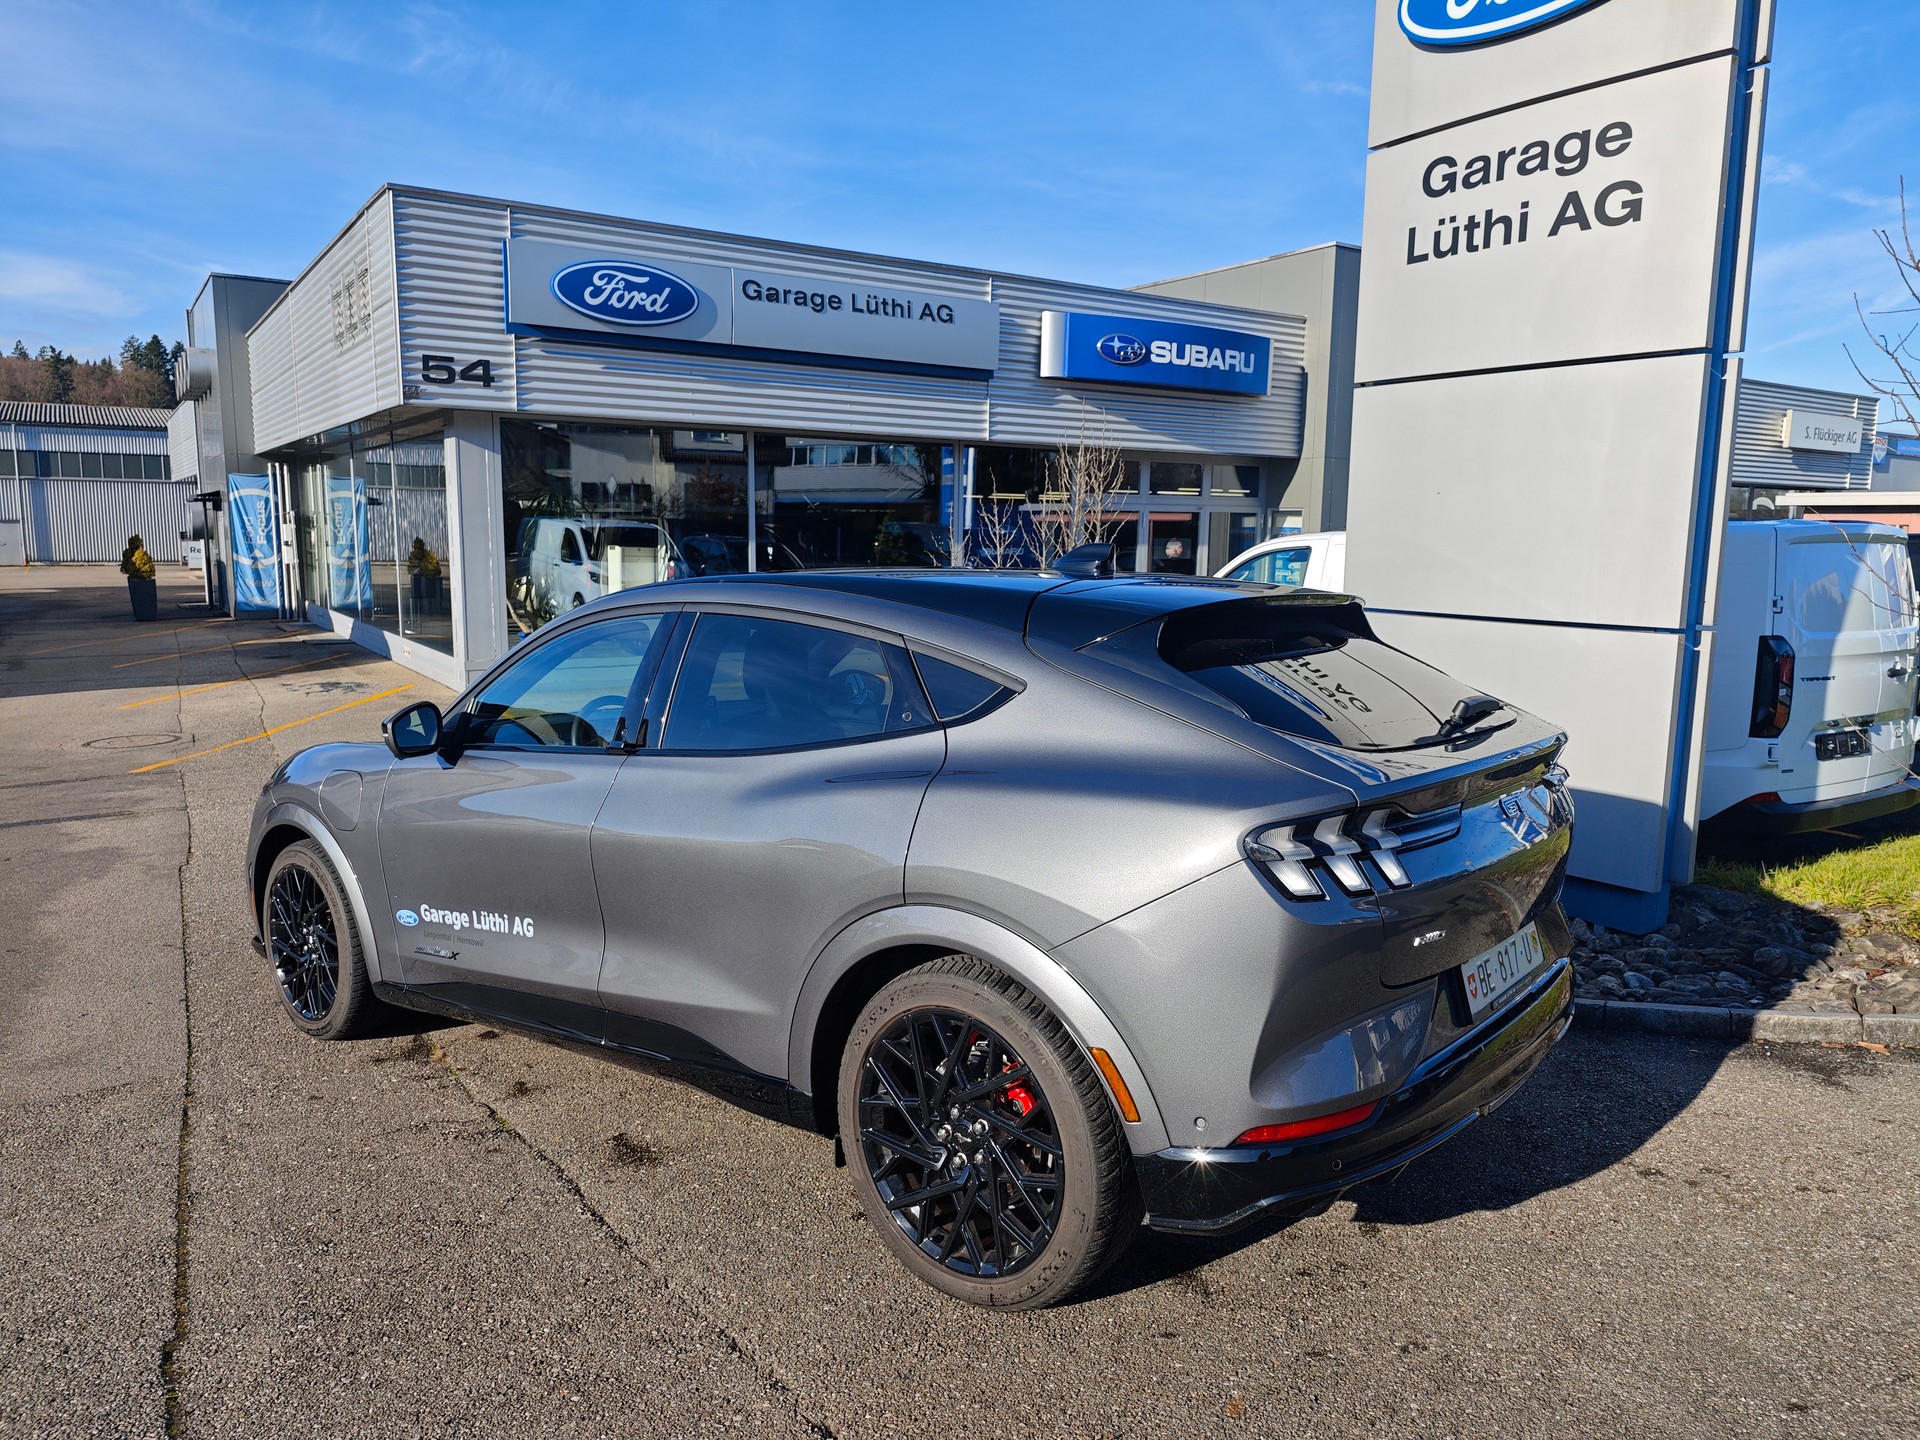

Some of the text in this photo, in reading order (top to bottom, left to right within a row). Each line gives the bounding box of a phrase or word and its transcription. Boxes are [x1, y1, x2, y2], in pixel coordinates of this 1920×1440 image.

[1422, 121, 1633, 199] Garage
[1406, 180, 1644, 266] Lüthi AG
[584, 270, 672, 313] Ford
[742, 280, 954, 324] Garage Lüthi AG
[422, 354, 496, 388] 54
[1150, 340, 1255, 374] SUBARU
[1804, 426, 1812, 440] S.
[1813, 427, 1845, 446] Flückiger
[1846, 432, 1858, 444] AG
[256, 500, 269, 545] Focus
[420, 903, 534, 938] Garage Lüthi AG
